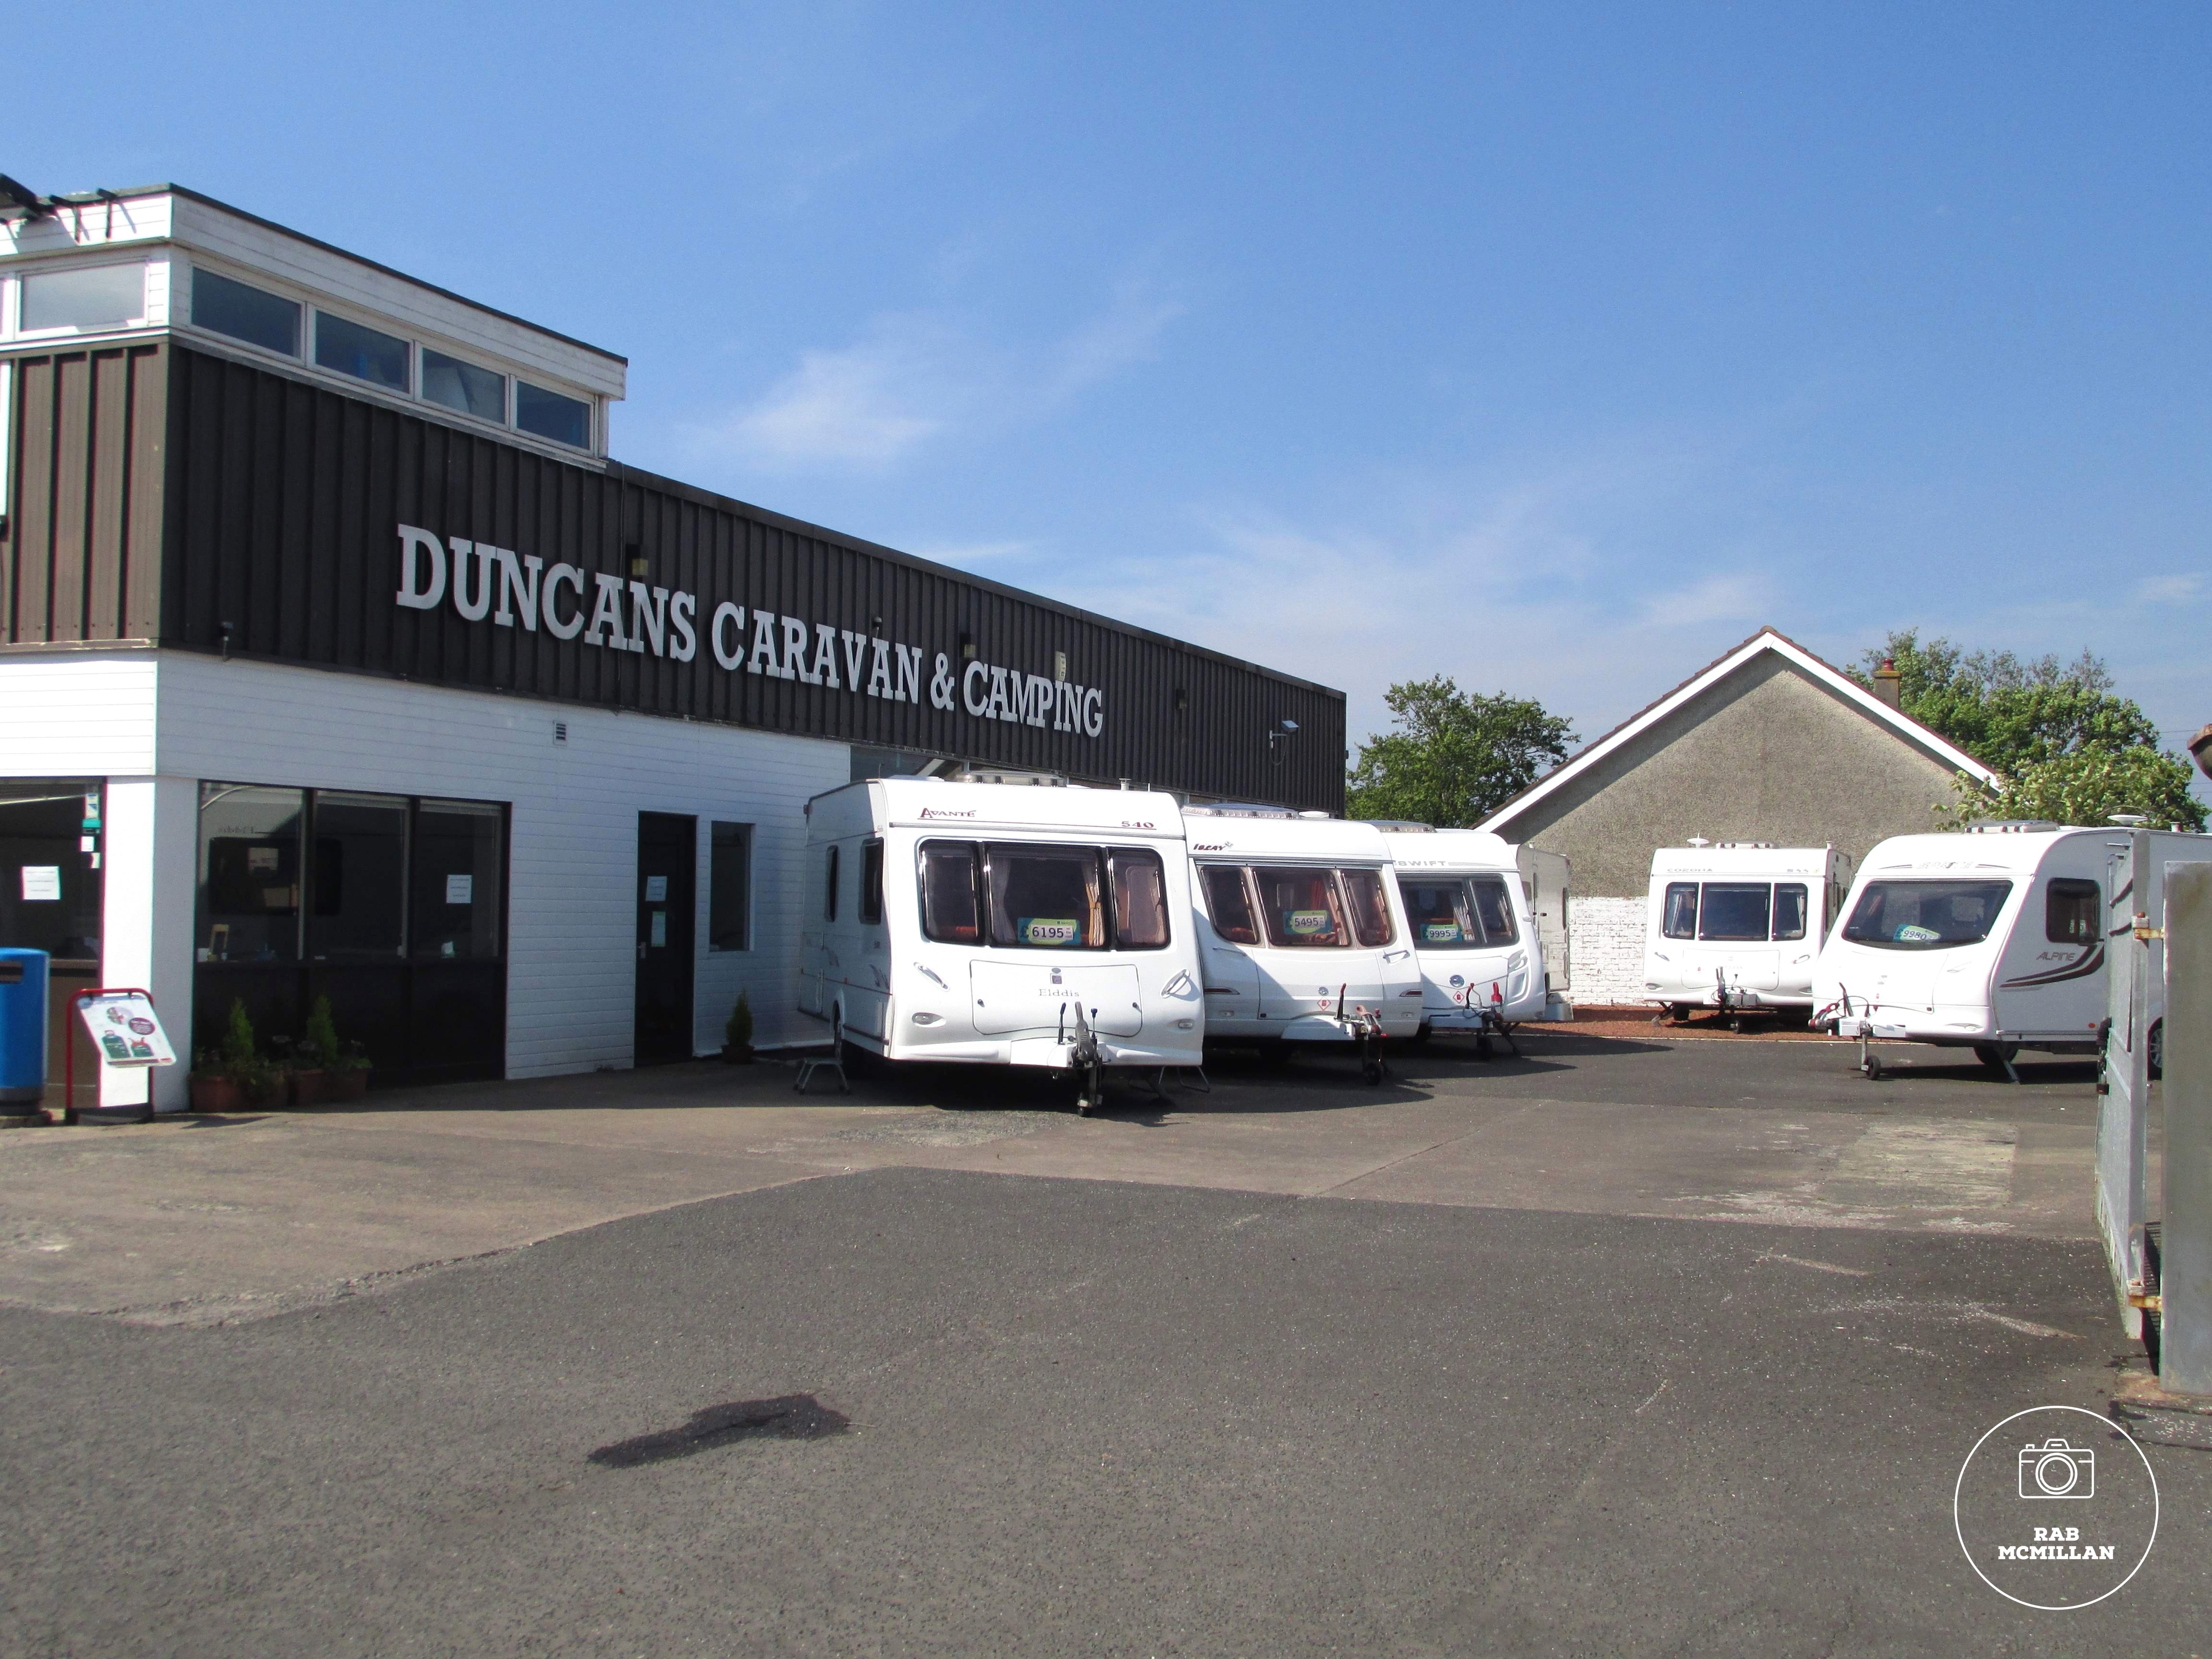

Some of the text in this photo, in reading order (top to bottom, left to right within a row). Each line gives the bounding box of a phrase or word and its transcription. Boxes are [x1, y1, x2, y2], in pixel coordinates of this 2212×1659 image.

[396, 523, 1104, 738] DUNCANS CARAVAN & CAMPING
[1294, 917, 1319, 926] 5495
[1032, 926, 1064, 938] 6195
[1903, 930, 1927, 940] 9980
[1038, 988, 1080, 997] Elddis
